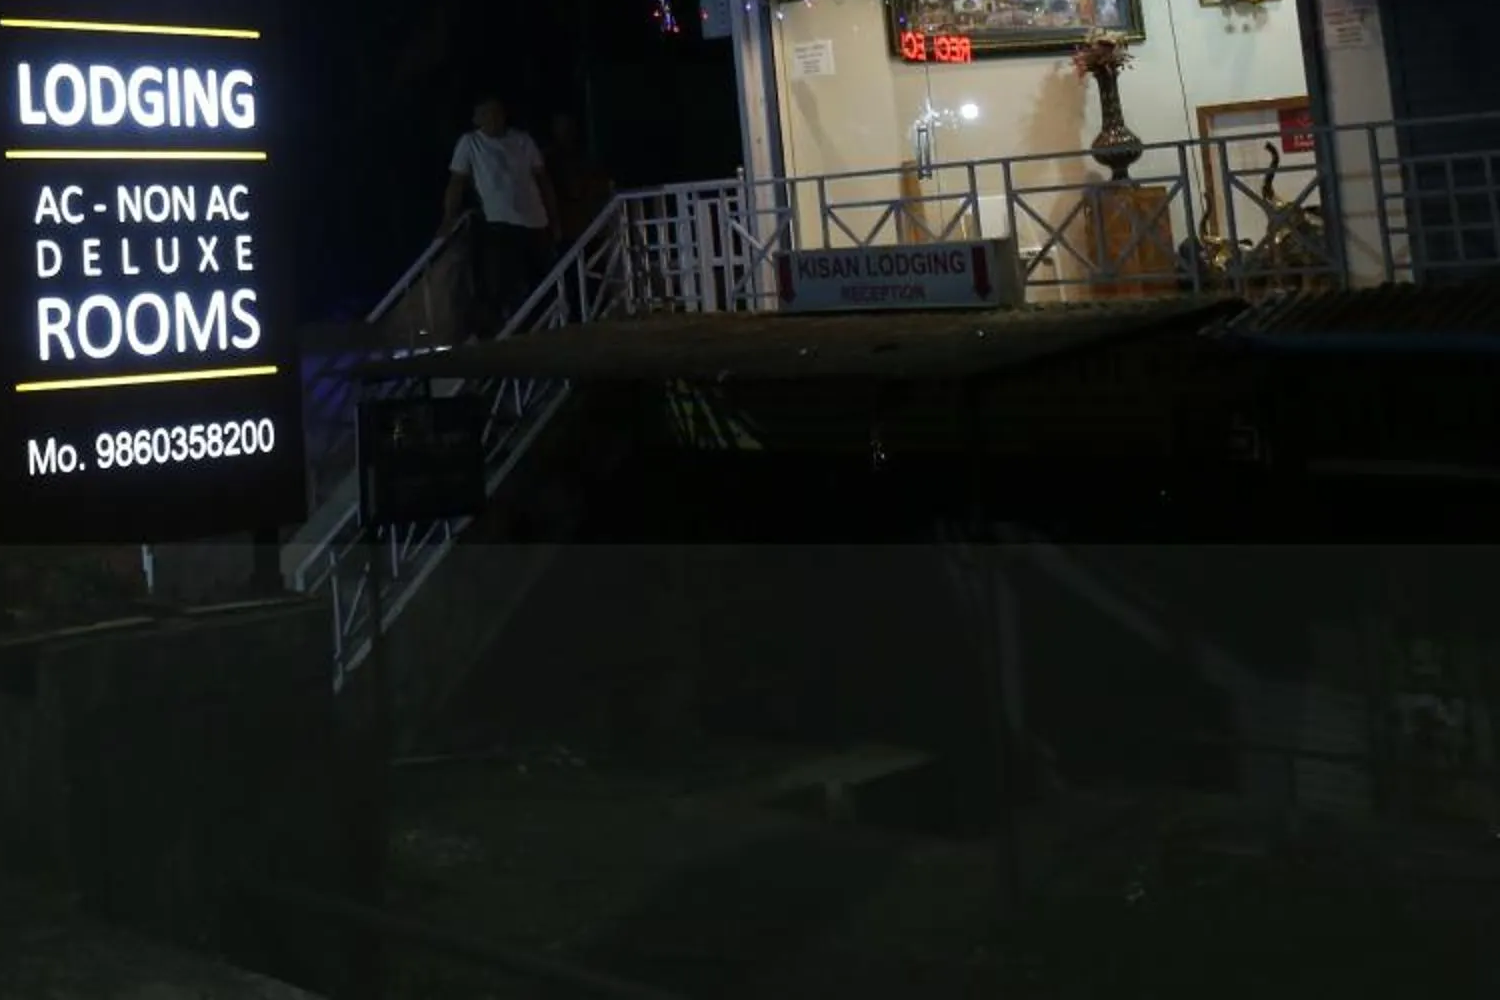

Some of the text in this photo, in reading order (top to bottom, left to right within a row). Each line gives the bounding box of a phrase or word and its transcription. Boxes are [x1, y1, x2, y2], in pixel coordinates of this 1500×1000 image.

[18, 61, 255, 129] LODGING
[35, 185, 84, 224] AC
[117, 185, 196, 223] NON
[206, 184, 249, 221] AC
[36, 235, 253, 278] DELUXE
[799, 251, 966, 279] KISAN LODGING
[38, 288, 260, 360] ROOMS
[28, 418, 274, 475] Mo. 9860358200
